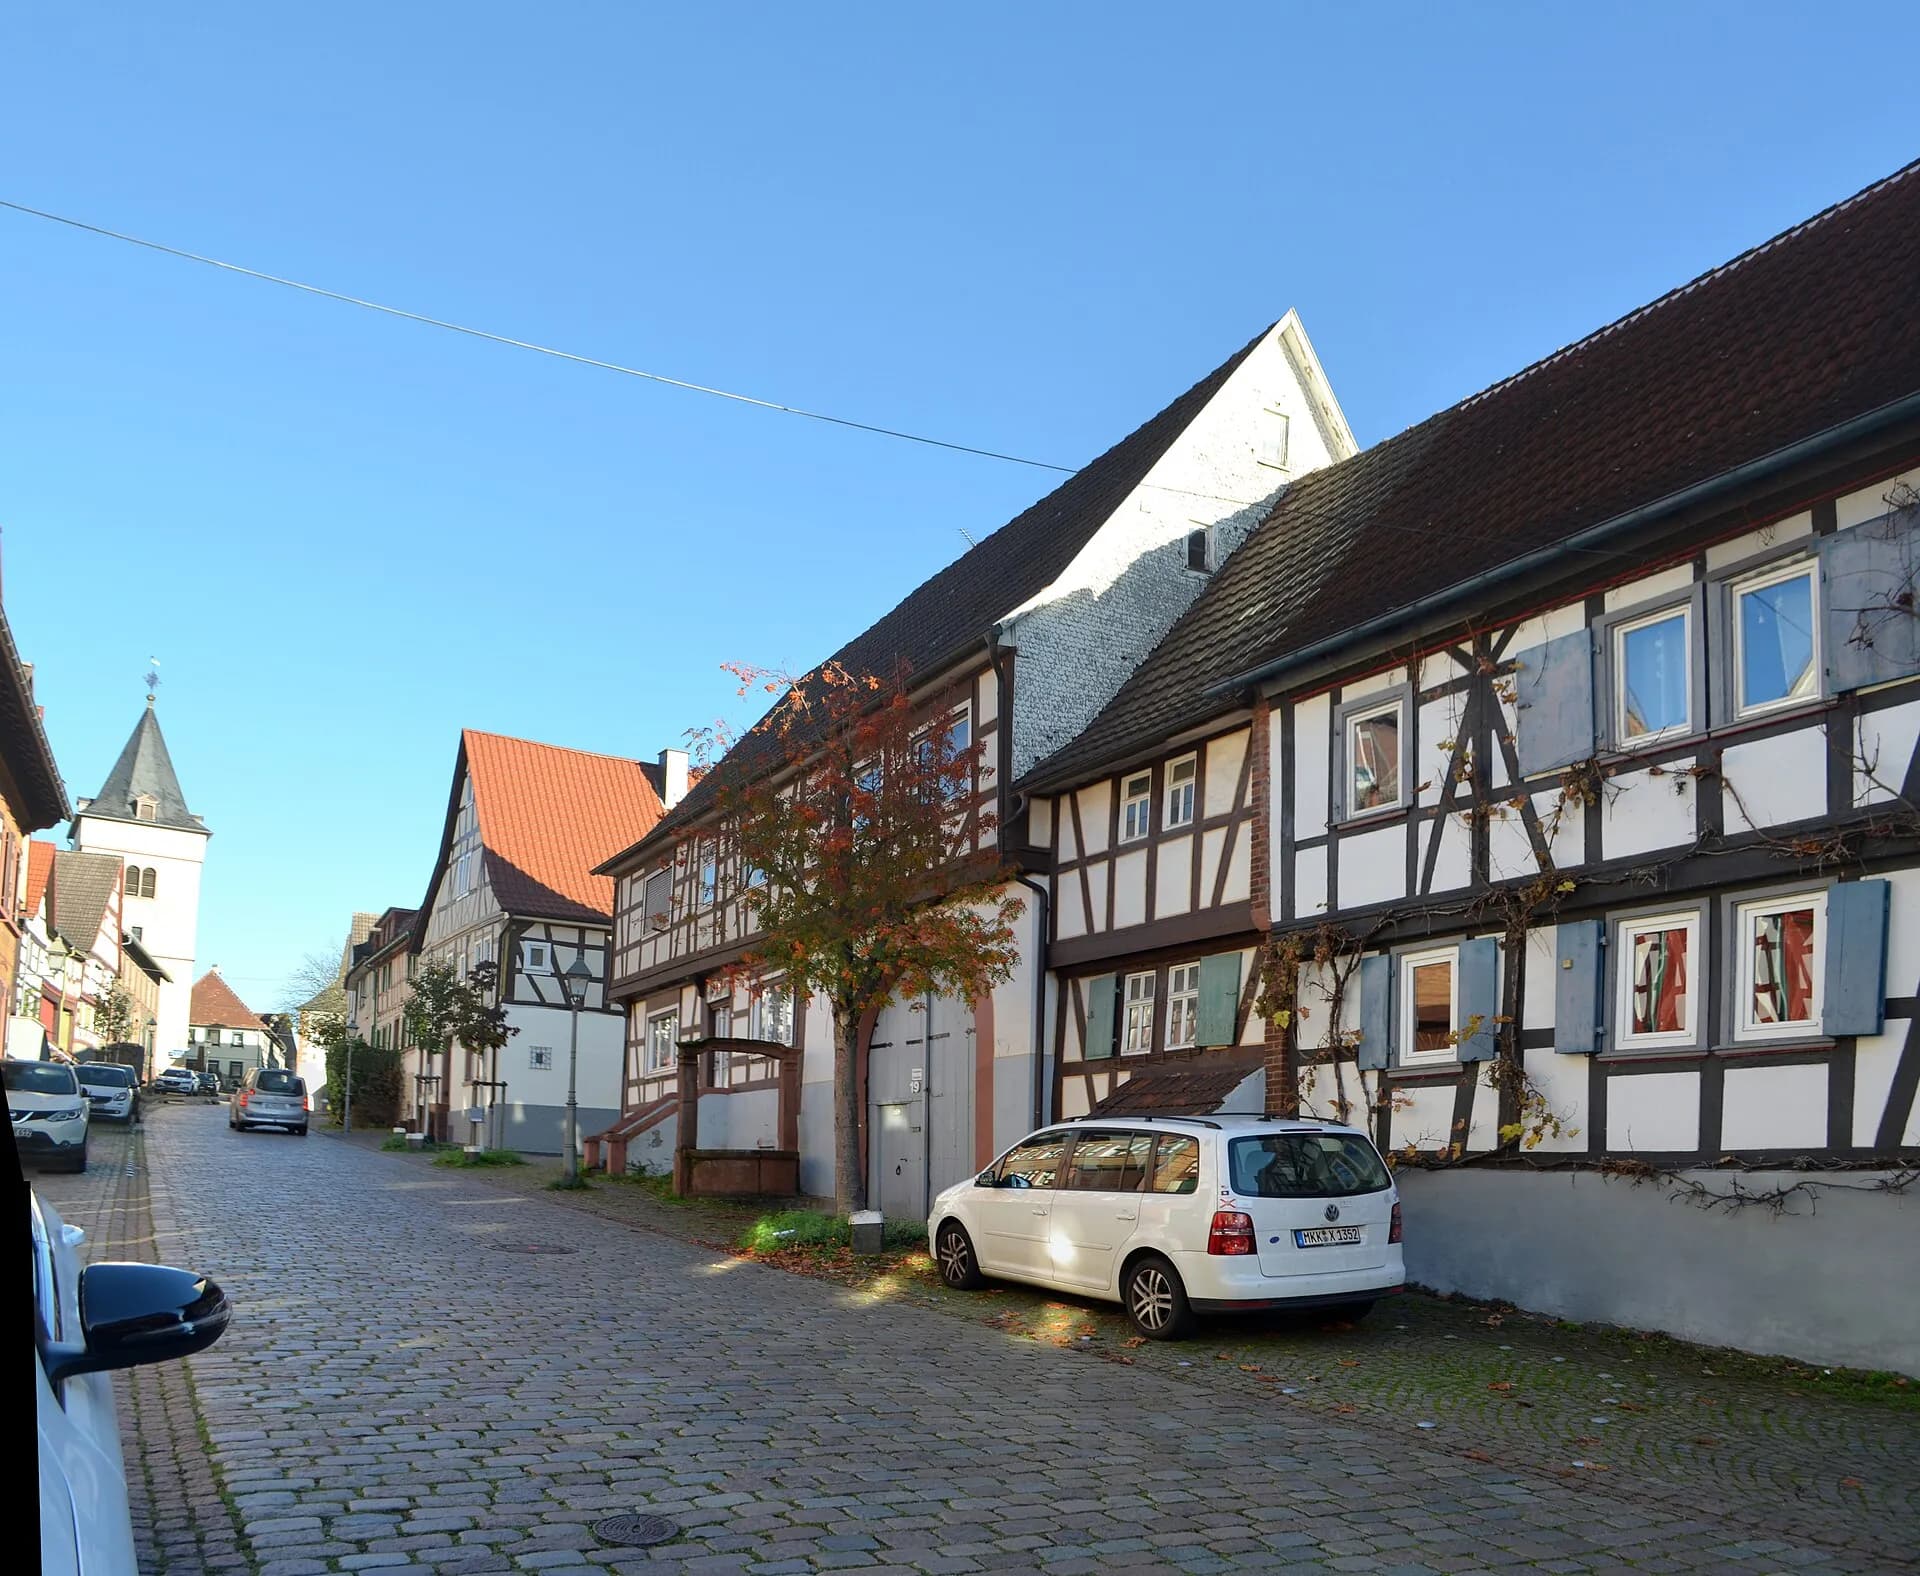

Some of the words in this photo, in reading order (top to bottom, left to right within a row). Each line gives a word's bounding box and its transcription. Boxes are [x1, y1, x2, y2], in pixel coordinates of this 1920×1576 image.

[909, 1081, 920, 1093] 19
[1303, 1231, 1323, 1243] MKK
[1328, 1230, 1336, 1241] X
[1337, 1228, 1358, 1240] 1352
